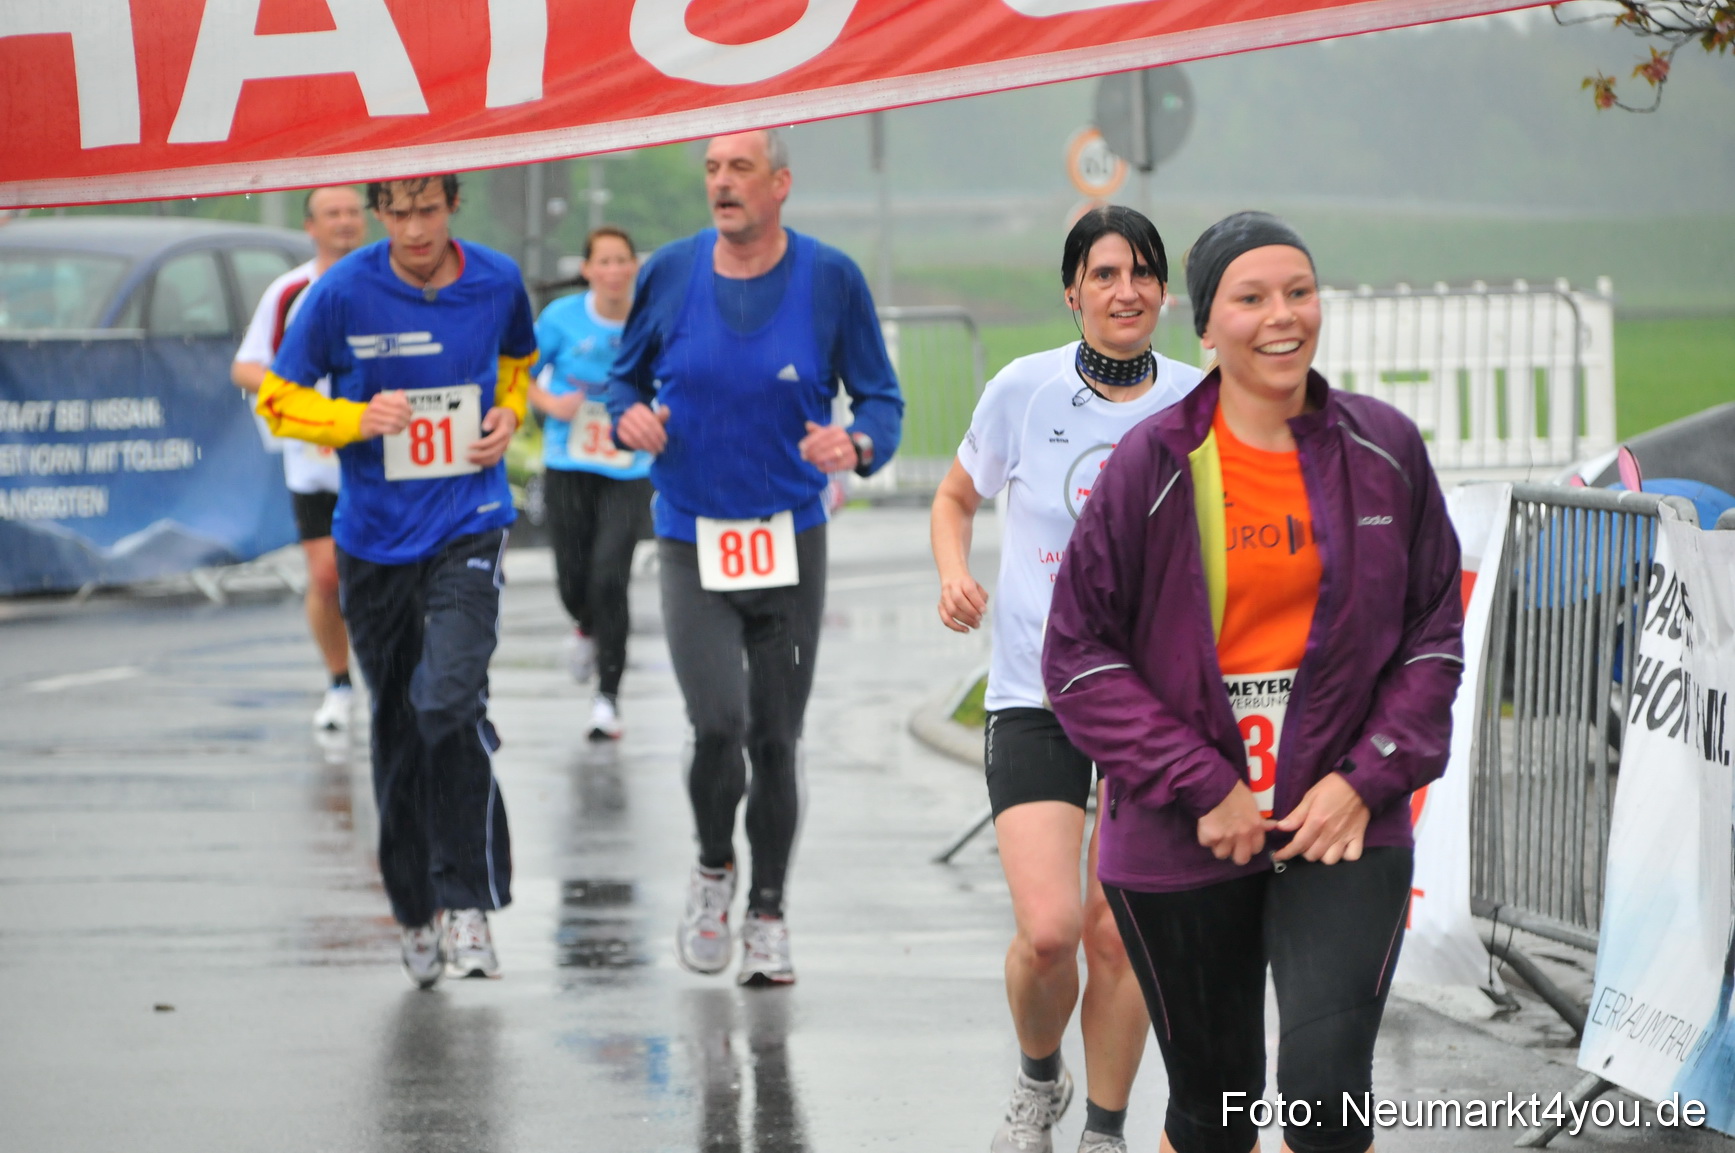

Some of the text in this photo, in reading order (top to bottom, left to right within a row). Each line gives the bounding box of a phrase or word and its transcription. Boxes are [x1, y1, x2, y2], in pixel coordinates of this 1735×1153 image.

[408, 416, 455, 467] 81
[719, 528, 775, 579] 80
[1223, 678, 1293, 697] MEYER
[1238, 714, 1277, 793] 3
